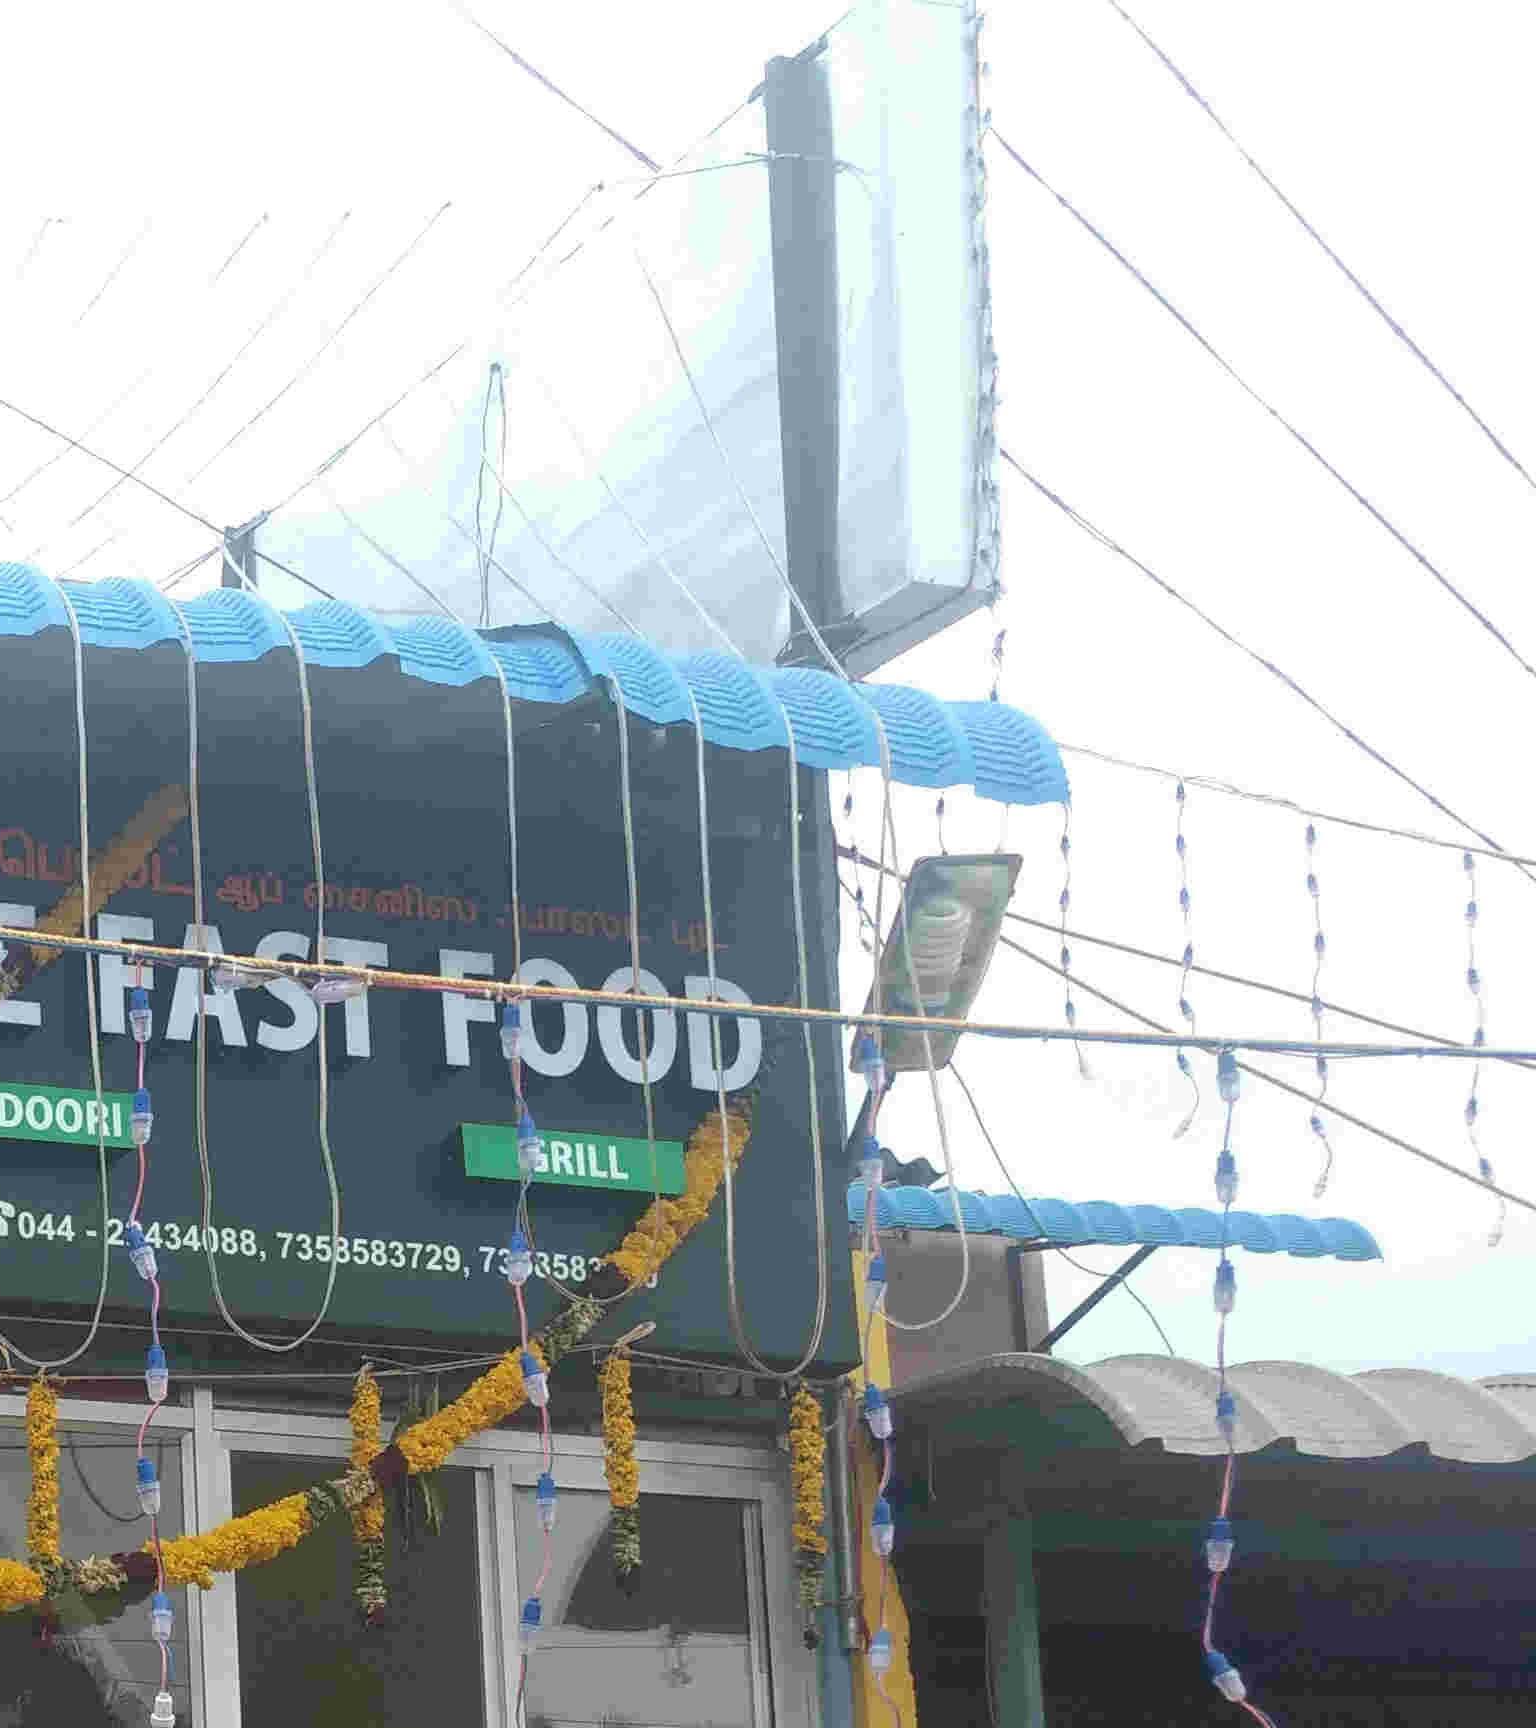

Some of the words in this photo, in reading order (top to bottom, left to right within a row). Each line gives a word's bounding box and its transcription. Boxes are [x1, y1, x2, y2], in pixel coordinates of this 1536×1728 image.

[97, 913, 389, 1058] FAST
[439, 949, 762, 1092] FOOD
[17, 1211, 76, 1242] 044
[107, 1217, 266, 1263] 2434088,
[275, 1231, 471, 1279] 7358583729,
